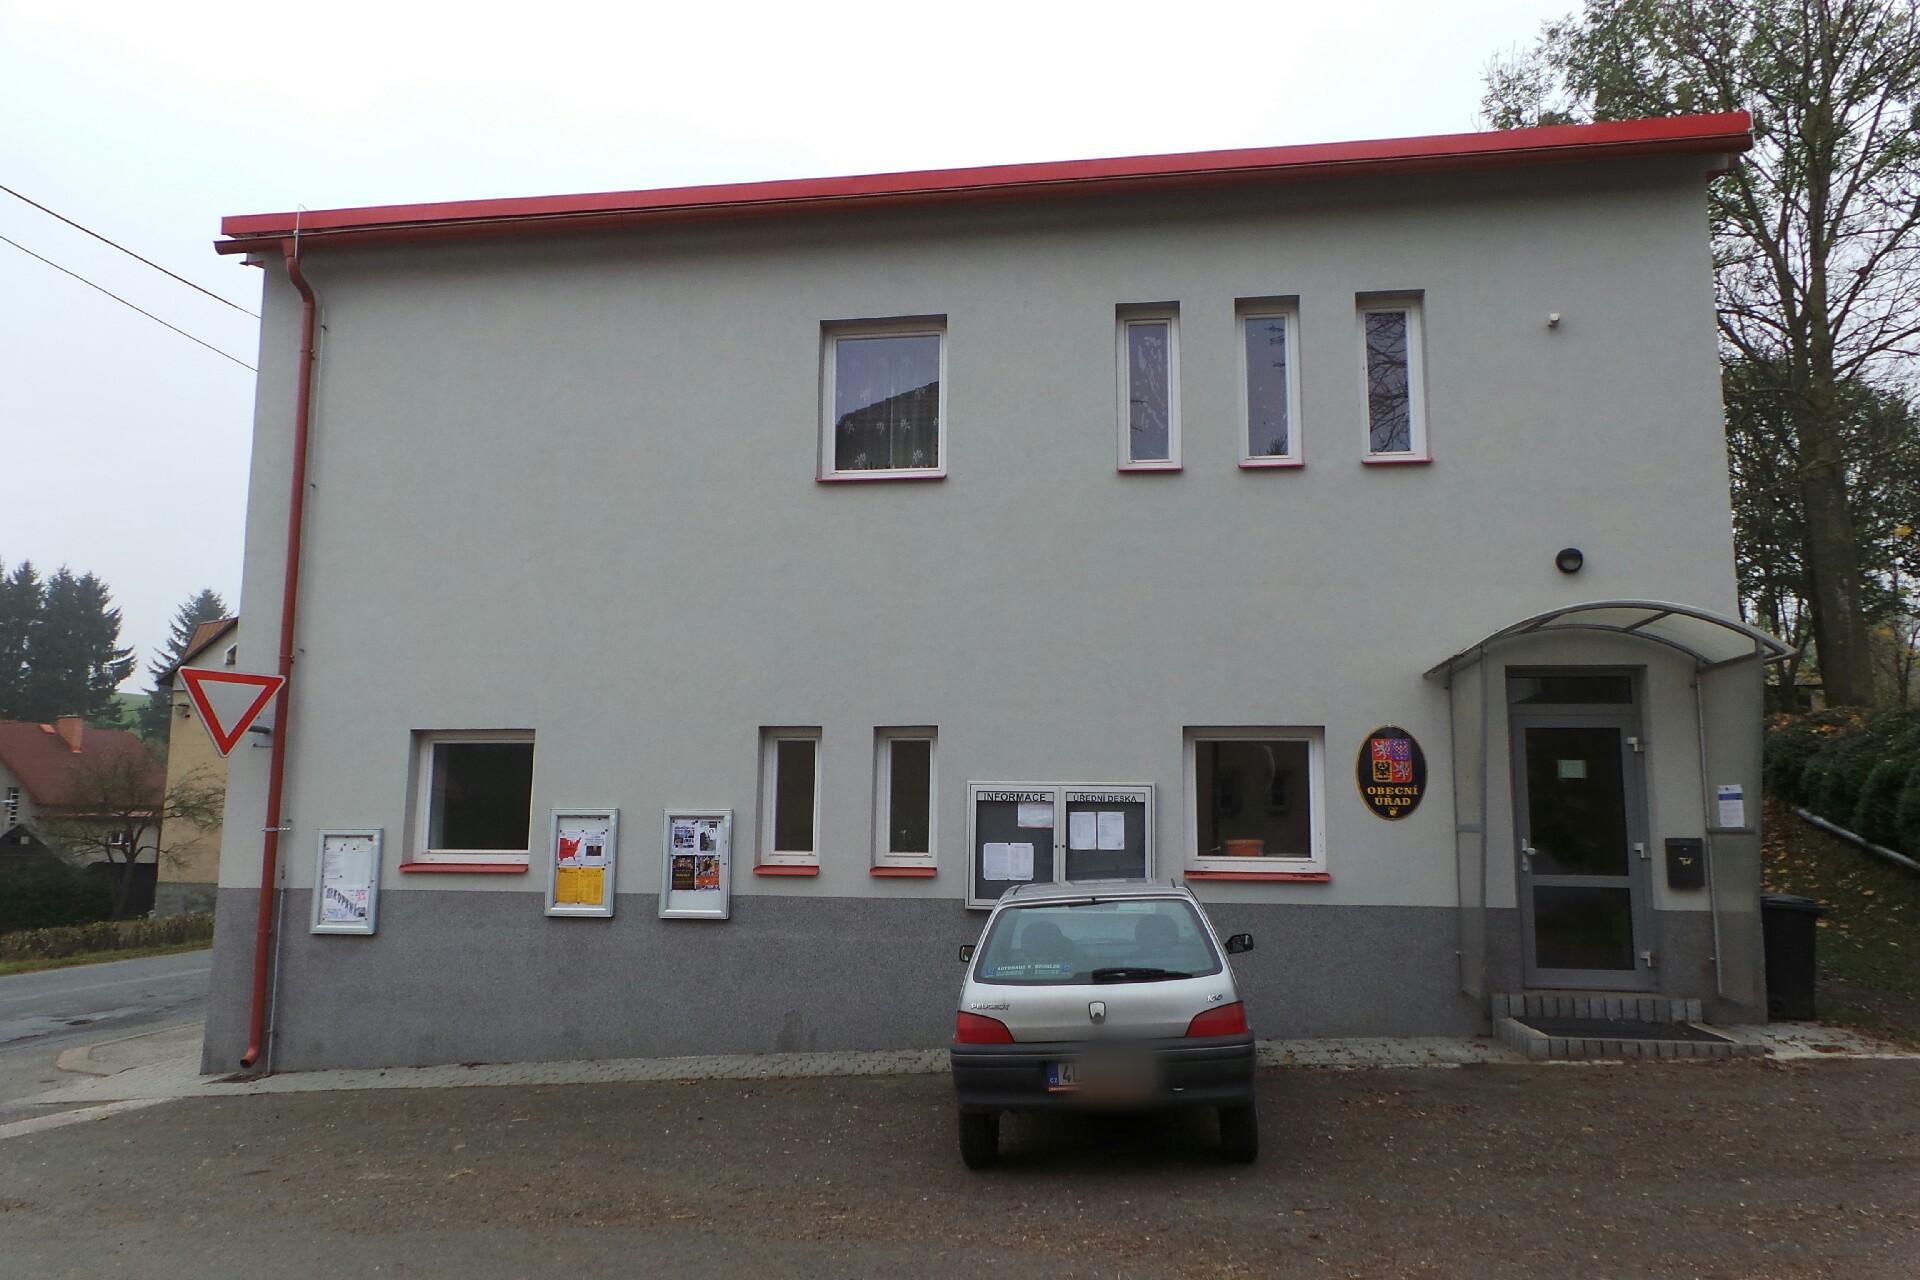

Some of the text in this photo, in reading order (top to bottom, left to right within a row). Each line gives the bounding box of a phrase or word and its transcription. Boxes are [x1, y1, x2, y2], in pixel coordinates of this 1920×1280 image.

[1367, 785, 1419, 795] OBECNÍ
[984, 792, 1046, 802] INFORMACE
[1107, 794, 1137, 803] DESKA
[1374, 795, 1411, 806] ÚŘAD
